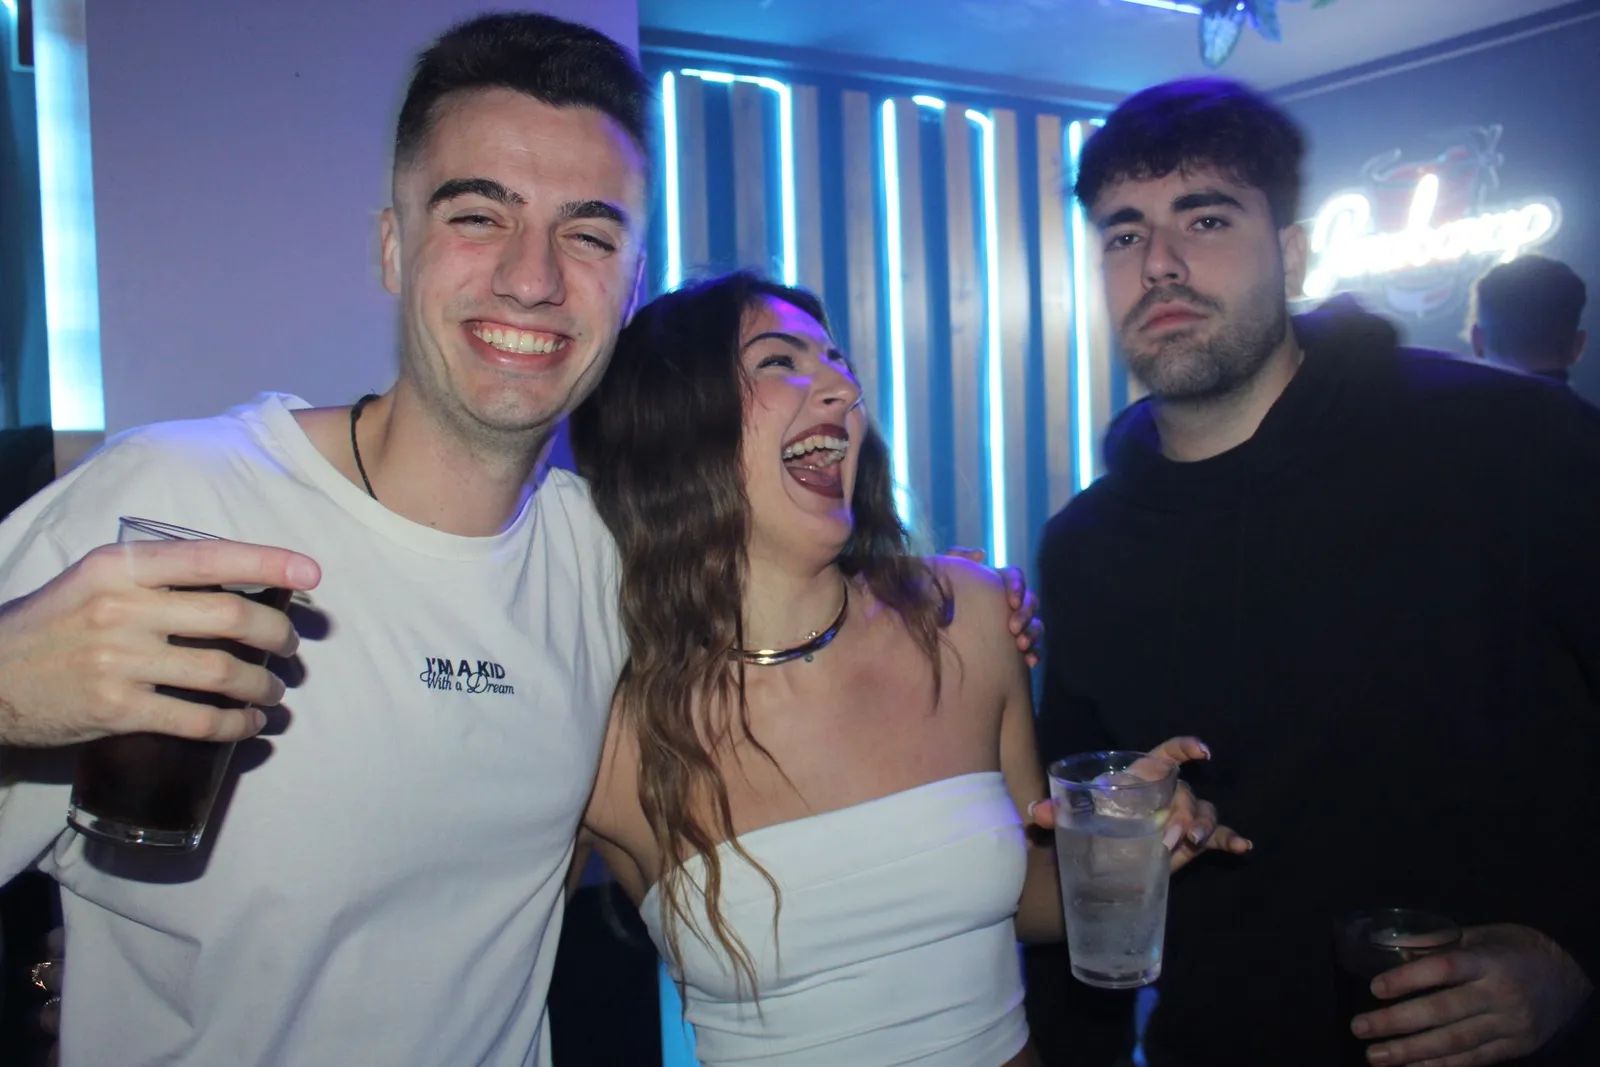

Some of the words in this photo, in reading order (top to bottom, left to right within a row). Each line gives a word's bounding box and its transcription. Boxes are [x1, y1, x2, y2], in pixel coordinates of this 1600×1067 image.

[425, 657, 454, 676] I'M
[457, 659, 473, 677] A
[477, 660, 506, 679] KID
[419, 670, 452, 690] With
[455, 681, 463, 691] a
[466, 672, 515, 694] Dream
